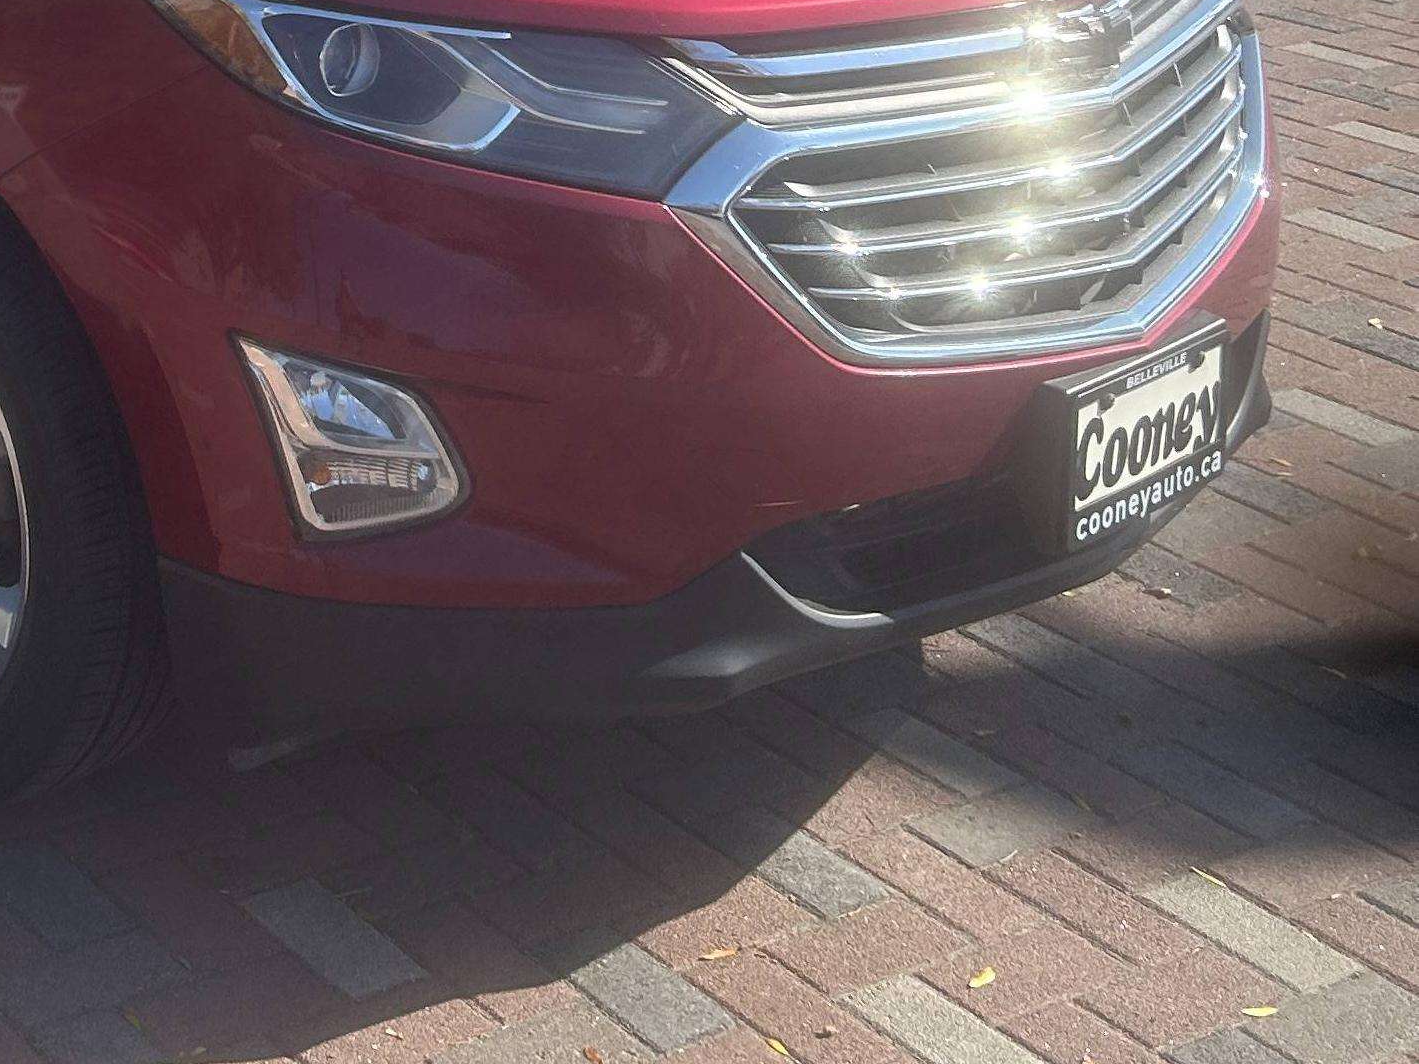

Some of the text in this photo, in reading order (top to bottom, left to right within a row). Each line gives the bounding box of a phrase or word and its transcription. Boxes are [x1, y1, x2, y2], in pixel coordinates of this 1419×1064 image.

[1125, 351, 1188, 389] BELLEVILLE
[1074, 380, 1222, 502] Cooney
[1075, 448, 1223, 541] cooneyauto.ca
